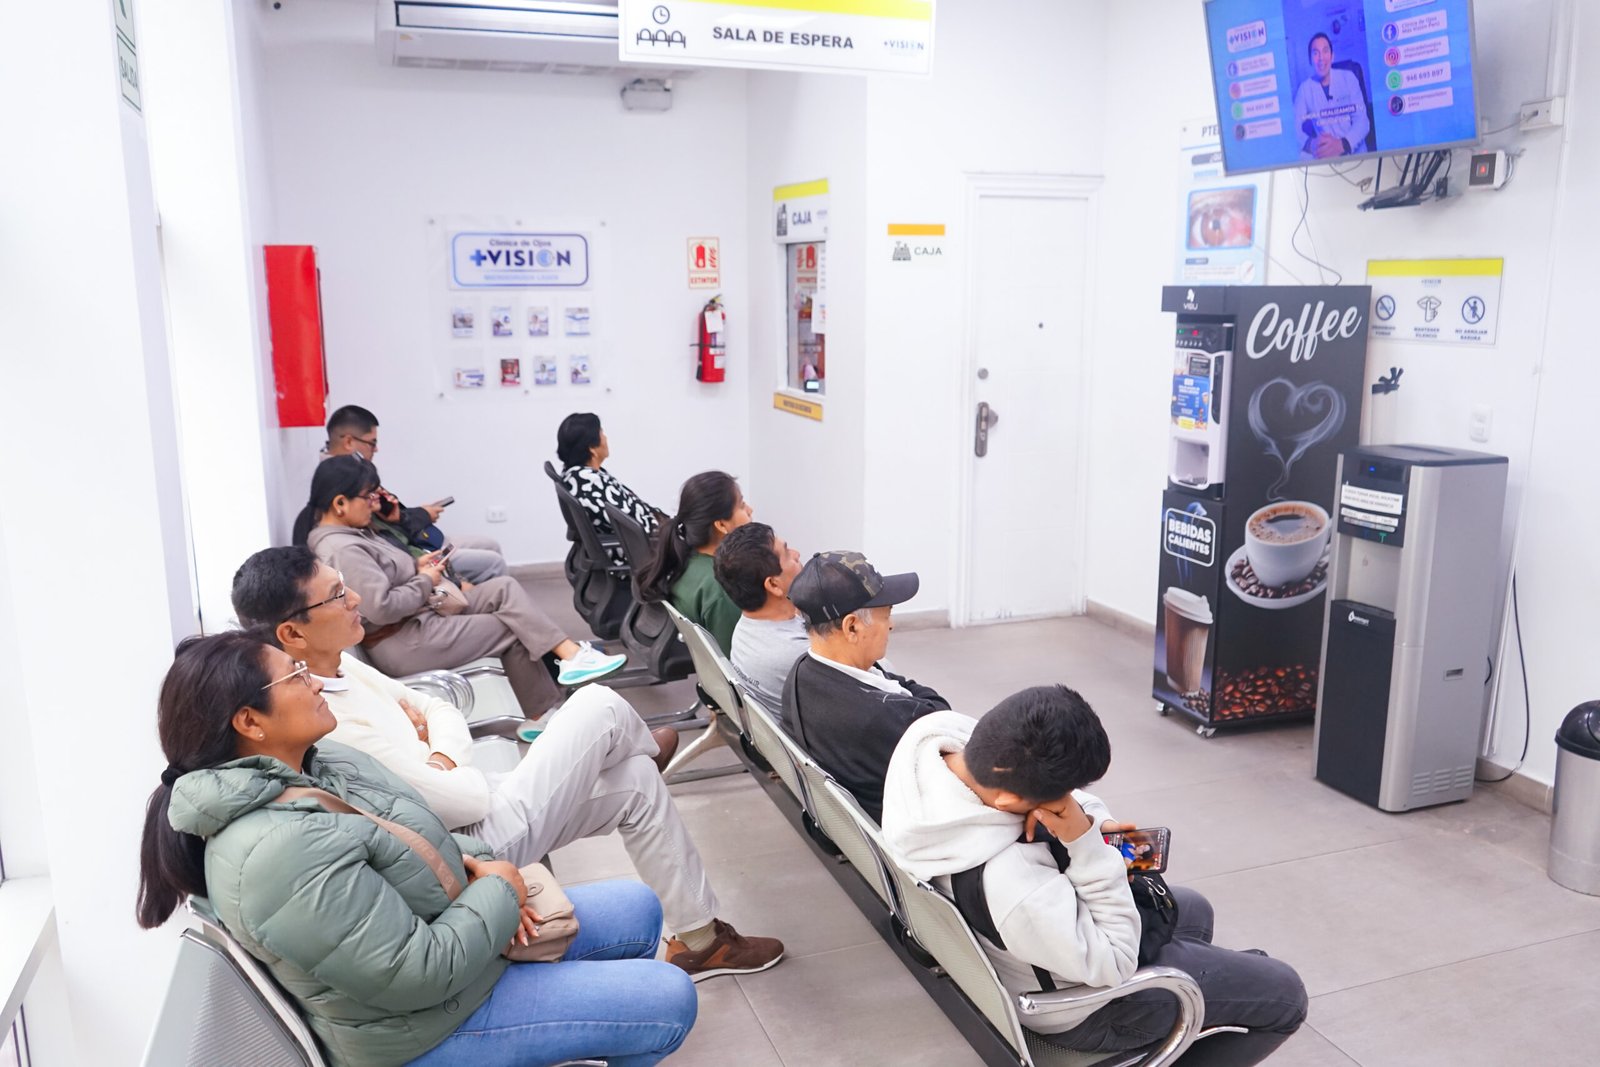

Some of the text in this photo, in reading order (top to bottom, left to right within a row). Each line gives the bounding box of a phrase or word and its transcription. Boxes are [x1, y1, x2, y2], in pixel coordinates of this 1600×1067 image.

[712, 26, 854, 49] SALA DE ESPERA
[1201, 124, 1220, 137] PTE
[792, 210, 812, 225] CAJA
[532, 239, 552, 248] Ojos
[914, 246, 943, 256] CAJA
[1246, 300, 1363, 363] Coffee
[1168, 518, 1212, 544] BEBIDAS
[1168, 532, 1210, 555] CALIENTES
